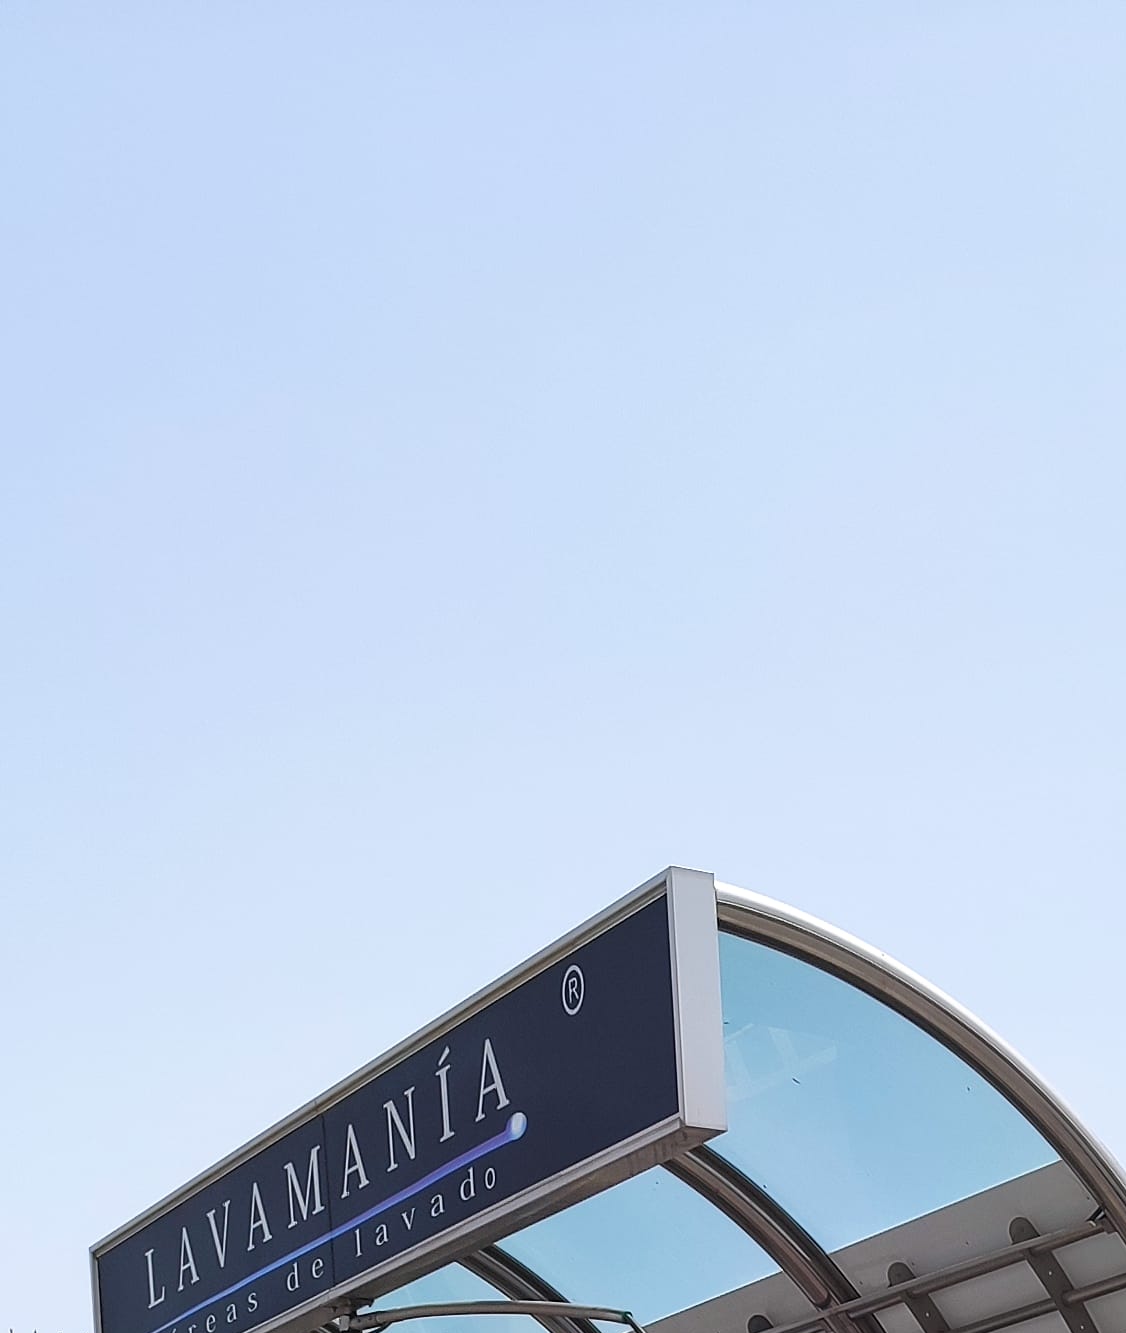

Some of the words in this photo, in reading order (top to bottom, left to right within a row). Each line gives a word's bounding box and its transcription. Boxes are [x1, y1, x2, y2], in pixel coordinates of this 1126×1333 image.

[145, 1038, 510, 1308] LAVAMANÍA
[286, 1256, 324, 1292] de
[355, 1164, 497, 1257] lavado
